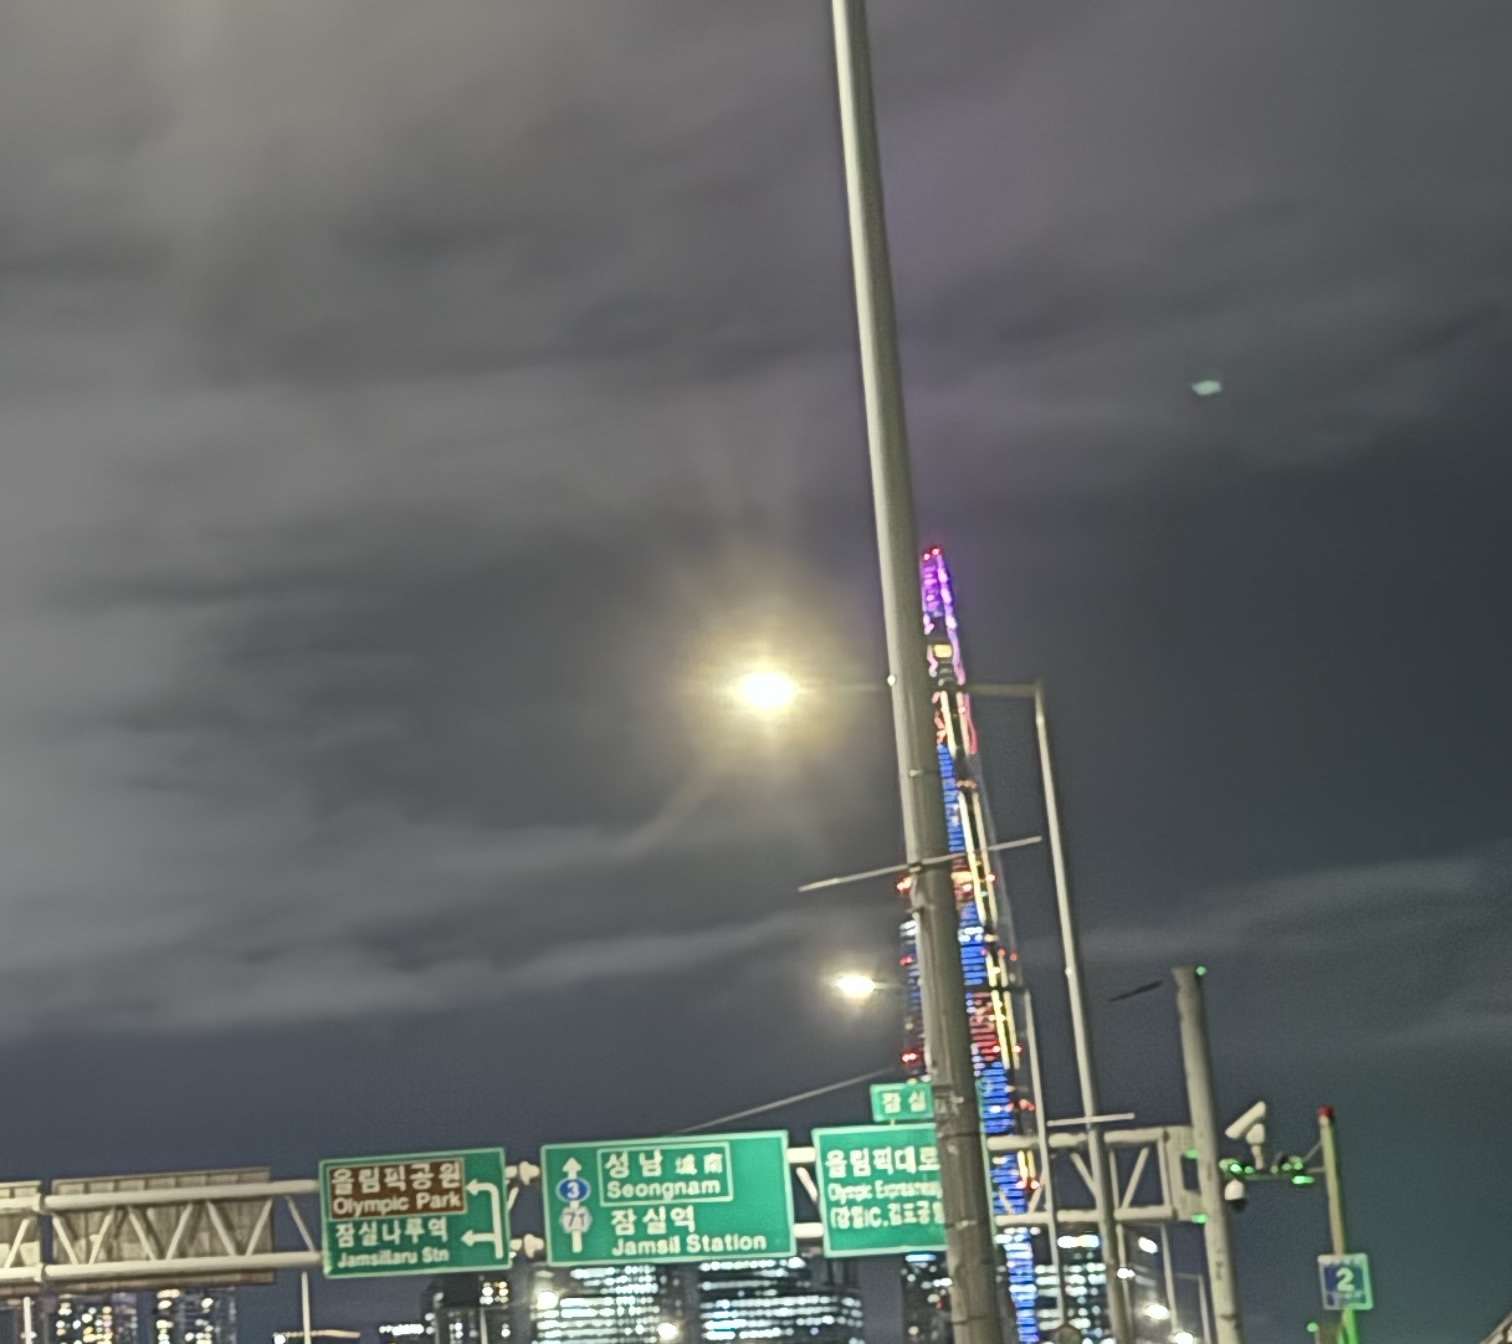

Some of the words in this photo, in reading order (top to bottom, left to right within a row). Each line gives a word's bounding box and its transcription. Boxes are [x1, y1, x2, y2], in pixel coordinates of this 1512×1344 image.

[605, 1149, 663, 1178] 성남
[825, 1146, 942, 1179] 올림픽대로
[331, 1161, 460, 1195] 올림픽공원
[567, 1182, 580, 1198] 3
[607, 1179, 721, 1201] Seongnam
[332, 1196, 409, 1217] Olympic
[416, 1191, 462, 1210] Park
[335, 1216, 448, 1248] 잠실나루역
[611, 1205, 696, 1236] 잠실역
[422, 1246, 450, 1264] Stn
[612, 1236, 680, 1256] Jamsil
[686, 1233, 767, 1253] Station
[1336, 1267, 1355, 1292] 2
